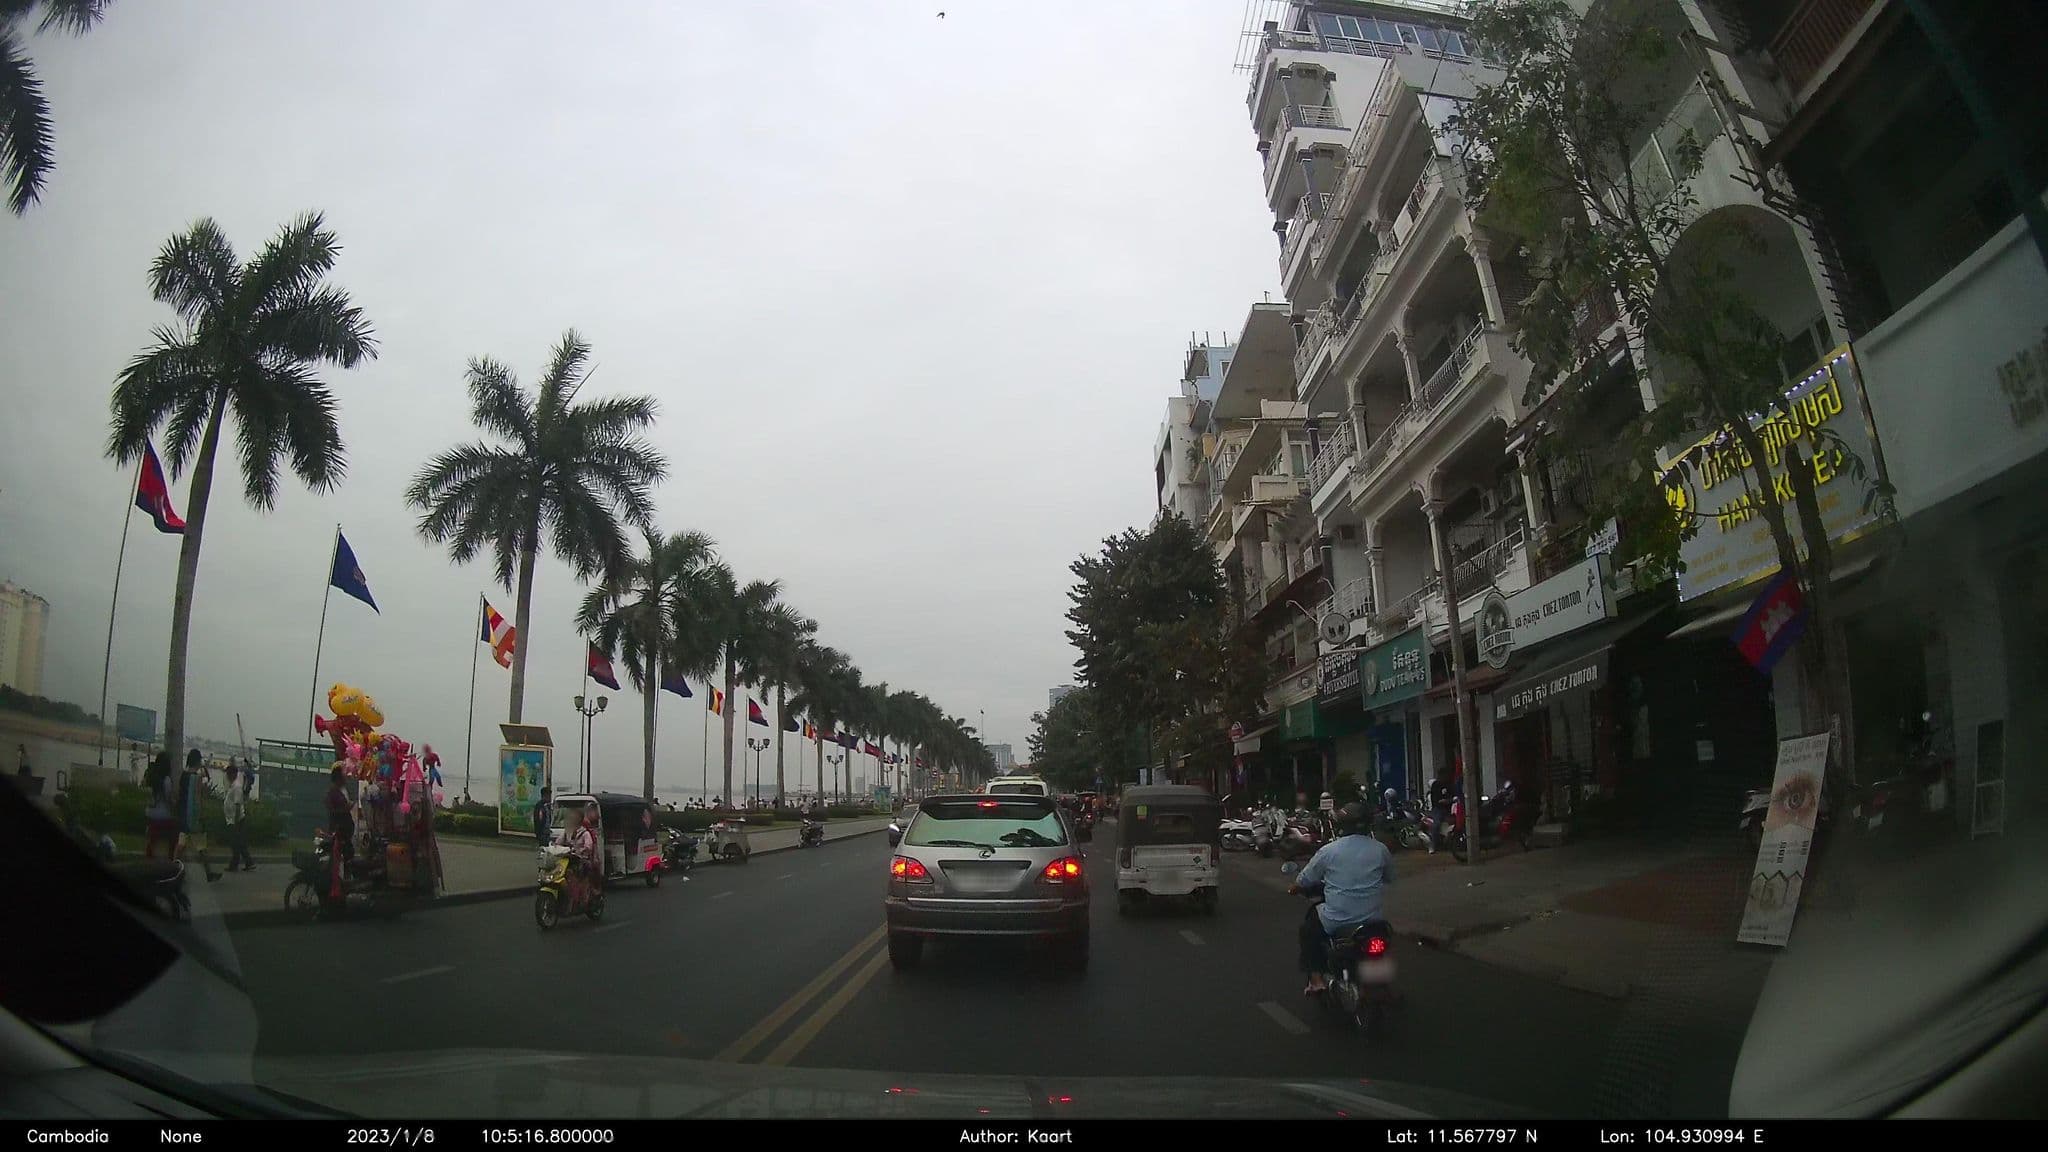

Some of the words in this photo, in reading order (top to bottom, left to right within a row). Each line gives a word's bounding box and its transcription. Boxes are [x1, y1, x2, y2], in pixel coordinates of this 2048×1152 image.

[1542, 602, 1558, 618] CHEZ
[1558, 590, 1582, 610] TONTON
[1483, 636, 1494, 650] CHEZ
[1550, 678, 1568, 696] CHEZ
[1568, 664, 1598, 690] TONTON
